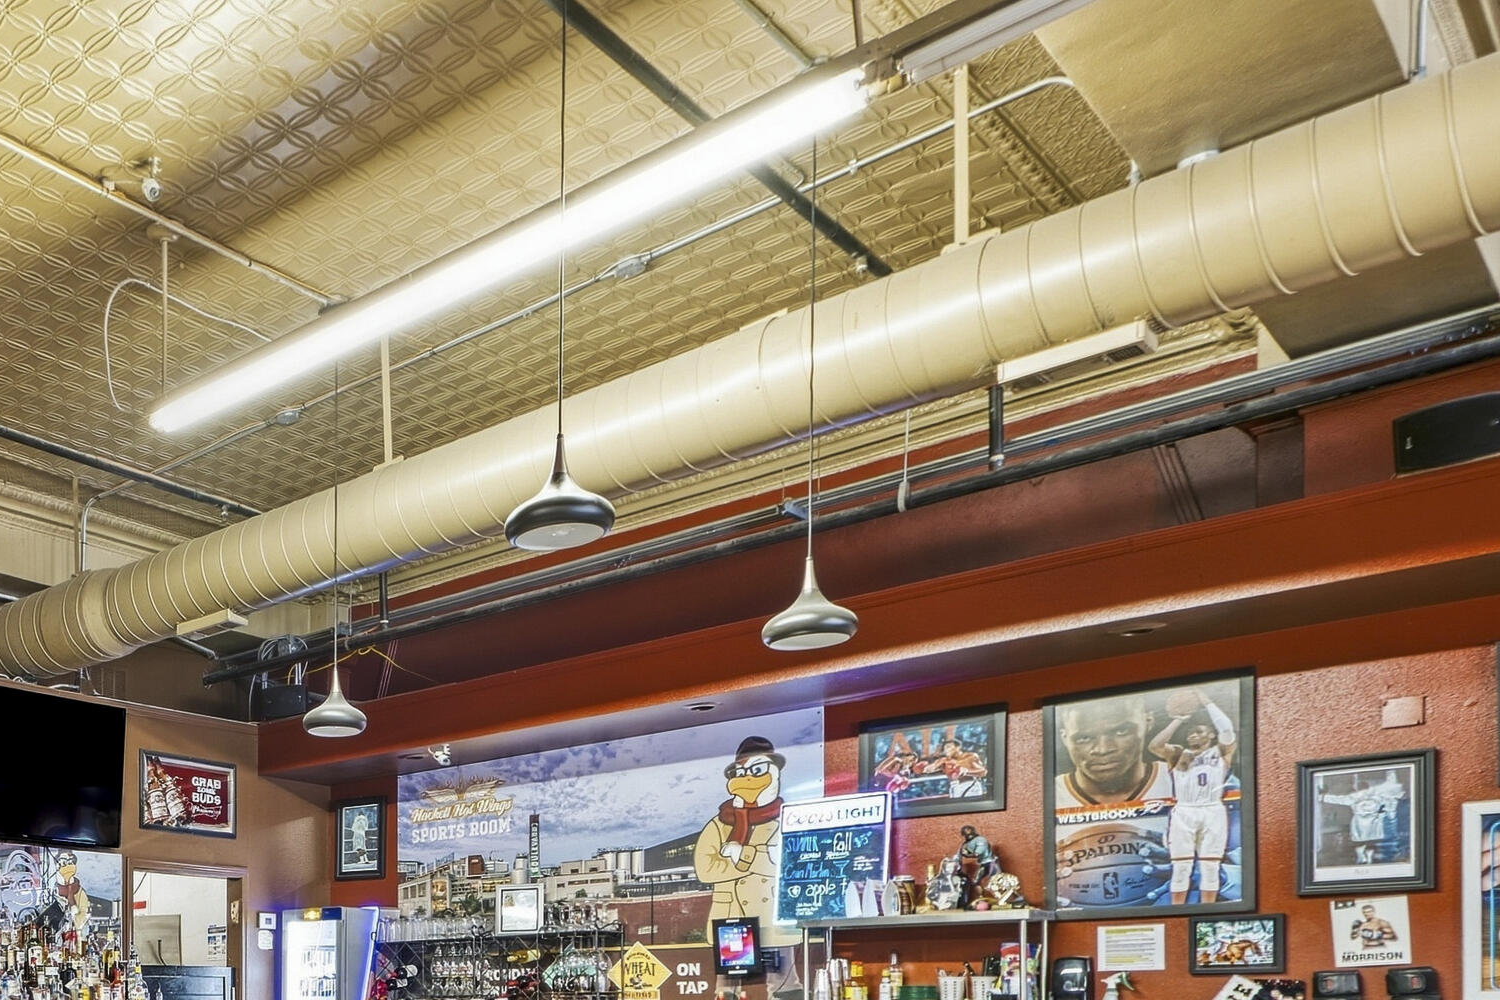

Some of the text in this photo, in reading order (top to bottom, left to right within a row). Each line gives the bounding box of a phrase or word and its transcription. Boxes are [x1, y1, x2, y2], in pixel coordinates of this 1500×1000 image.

[191, 776, 222, 790] GRAB
[192, 793, 222, 806] BUDS
[451, 802, 475, 818] Hot
[475, 796, 514, 816] Wings
[837, 805, 881, 820] LIGHT
[1058, 809, 1138, 825] WESTBROOK
[411, 818, 512, 844] SPORTS ROOM
[1066, 842, 1145, 867] SPALDIN
[1341, 951, 1403, 962] MORRISON
[623, 961, 657, 976] WHEAT
[676, 963, 701, 976] ON
[676, 981, 709, 995] TAP
